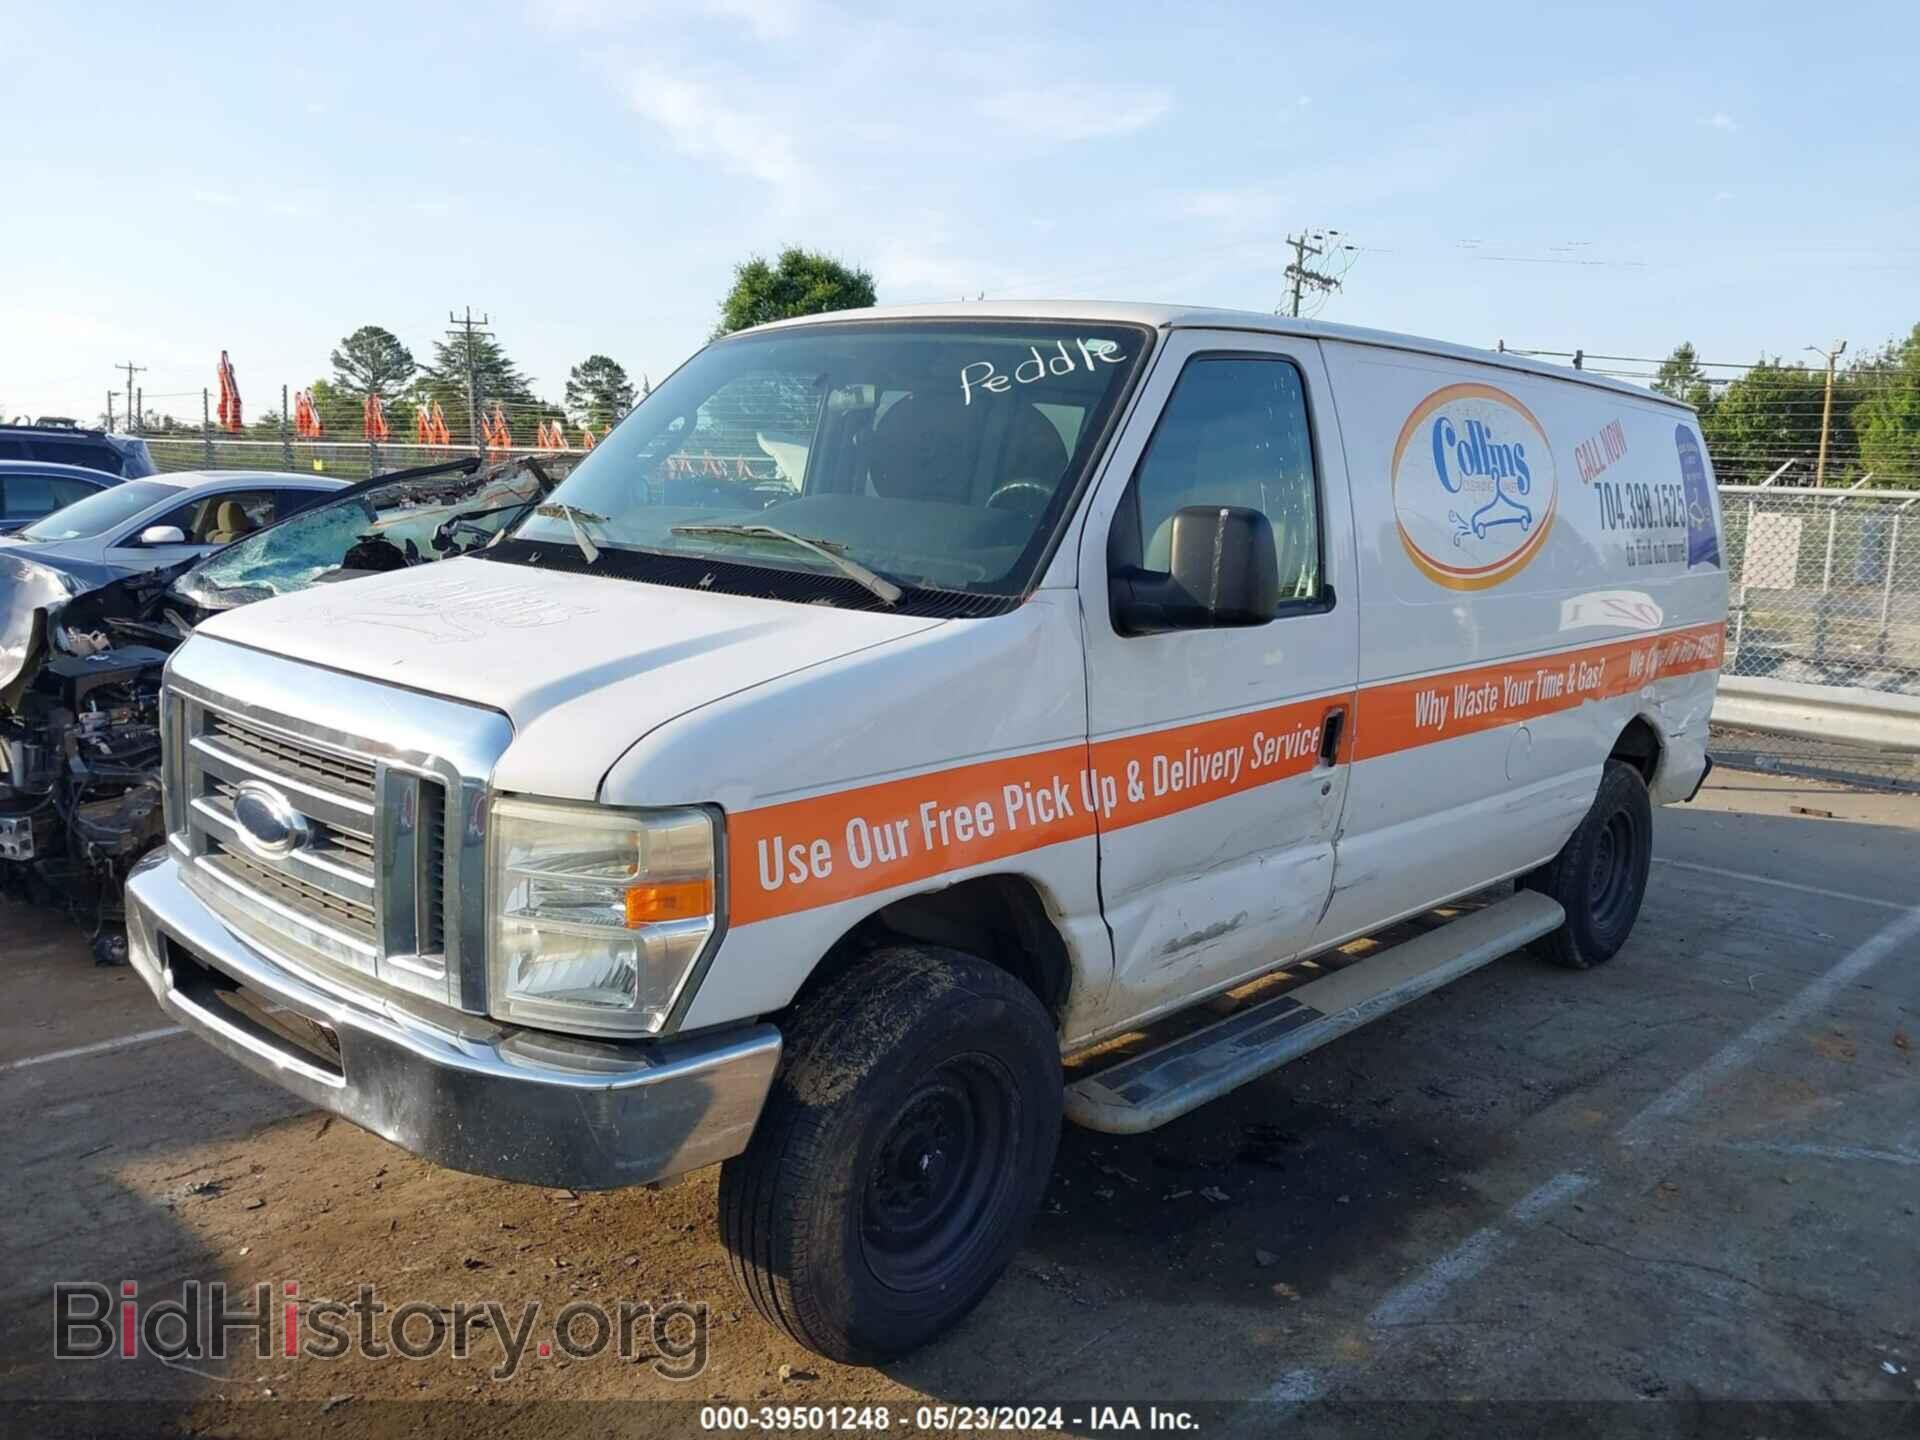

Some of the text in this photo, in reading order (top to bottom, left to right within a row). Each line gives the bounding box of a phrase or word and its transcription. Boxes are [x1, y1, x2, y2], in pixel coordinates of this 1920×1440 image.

[961, 338, 1127, 405] Peddle
[1432, 417, 1530, 495] Collins
[1575, 418, 1627, 484] CALL NOW
[1594, 482, 1686, 530] 704.398.1525
[1415, 689, 1449, 731] Why
[1453, 682, 1499, 720] Waste
[1503, 676, 1534, 709] Your
[1536, 669, 1563, 701] Time
[1566, 663, 1577, 694] &
[1577, 657, 1606, 691] Gas?
[1627, 649, 1645, 678] We
[757, 723, 1321, 891] Use Our Free Pick Up & Delivery Service
